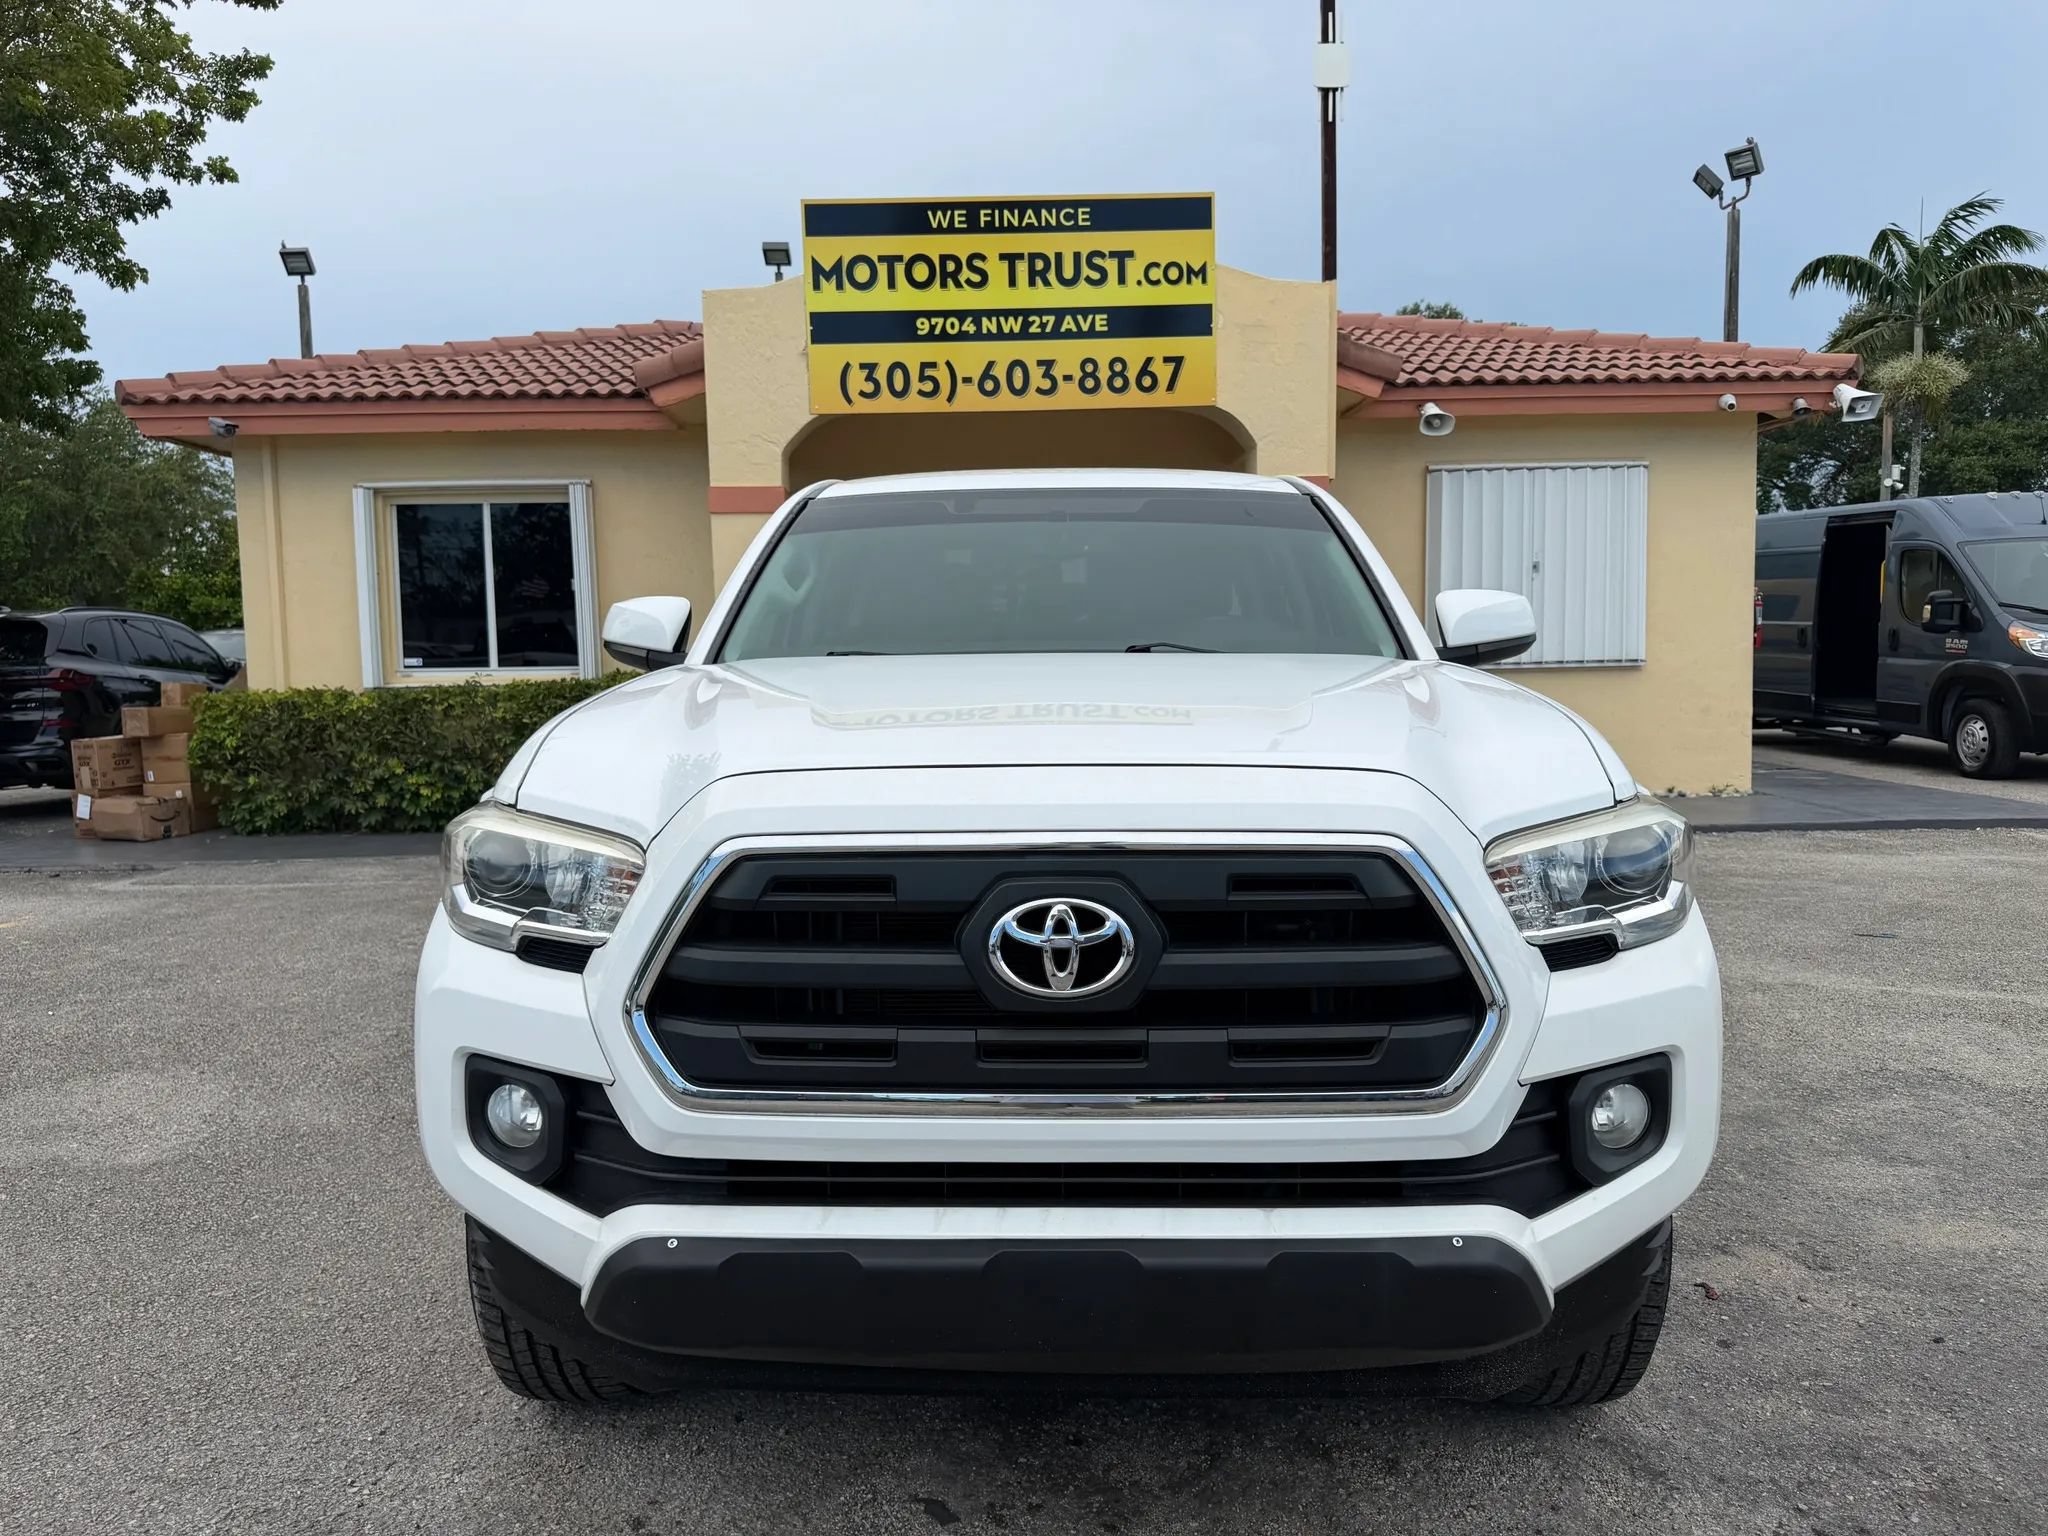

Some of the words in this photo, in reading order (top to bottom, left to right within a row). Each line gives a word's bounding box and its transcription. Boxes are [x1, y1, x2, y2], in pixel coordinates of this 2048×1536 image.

[928, 209, 967, 229] WE
[979, 207, 1091, 228] FINANCE
[811, 252, 989, 293] MOTORS
[916, 317, 977, 336] 9704
[982, 316, 1023, 335] NW
[1028, 315, 1056, 334] 27
[1060, 314, 1108, 333] AVE
[839, 355, 1186, 407] (305)-603-8867
